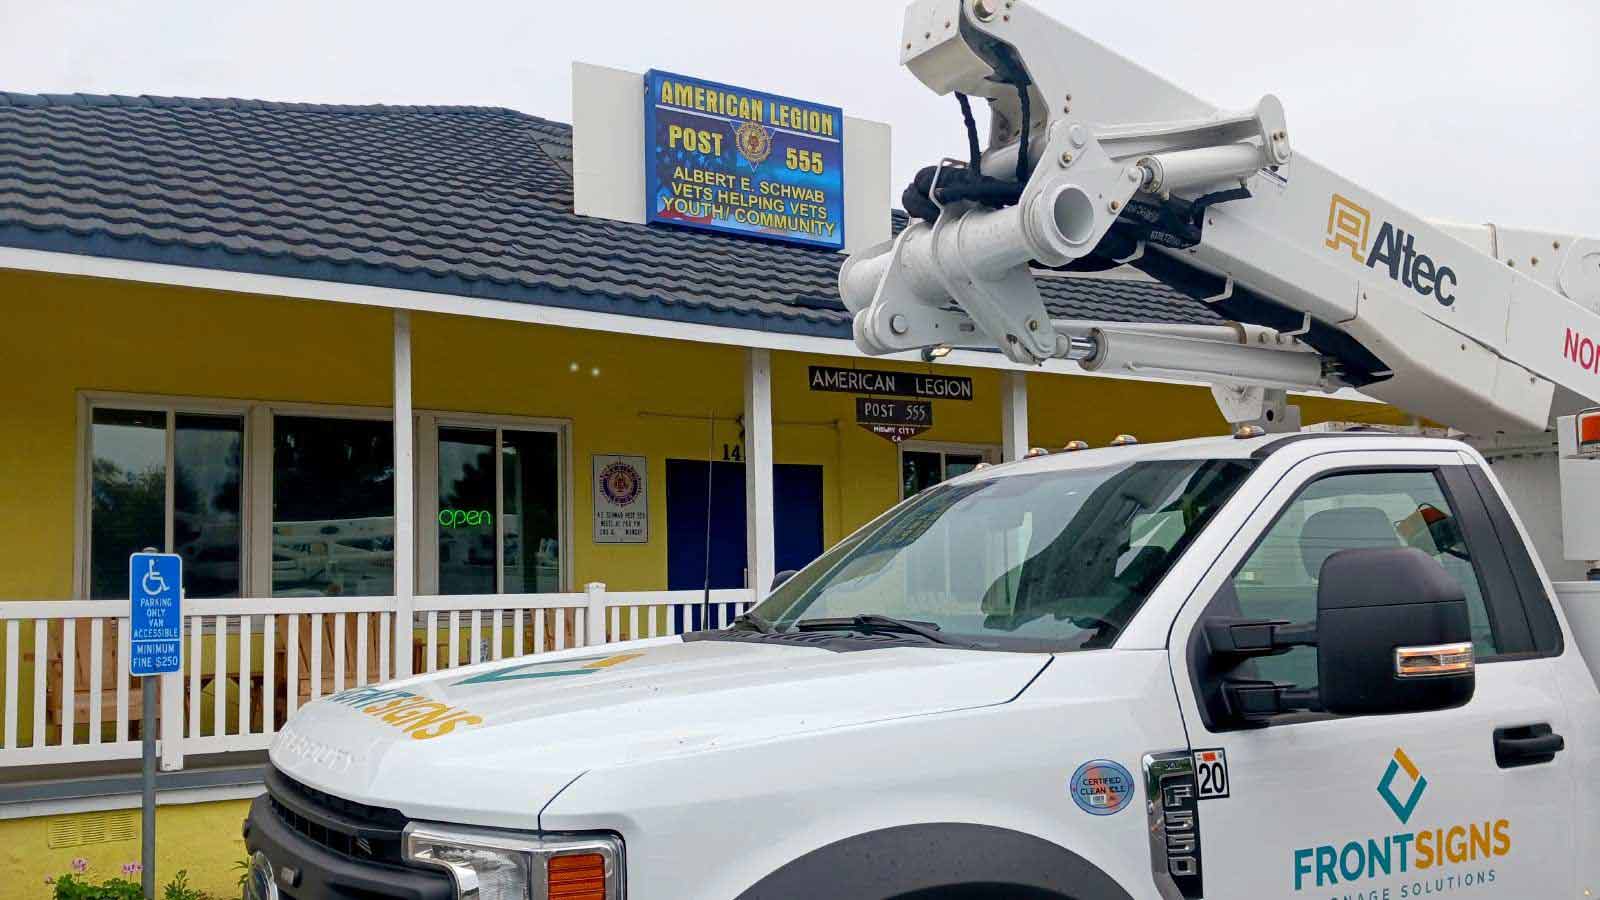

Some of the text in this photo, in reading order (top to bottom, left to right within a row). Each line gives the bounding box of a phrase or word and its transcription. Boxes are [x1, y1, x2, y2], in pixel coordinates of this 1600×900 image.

[661, 80, 833, 136] AMERICAN LEGION
[669, 124, 723, 157] POST
[786, 147, 824, 174] 555
[673, 166, 825, 203] ALBERT E. SCHWAB
[672, 182, 828, 219] VETS HELPING VETS
[663, 197, 835, 237] YOUTH/ COMMUNITY
[1366, 221, 1457, 307] Altec
[812, 369, 971, 397] AMERICAN LEGION
[865, 402, 926, 421] POST 555
[898, 427, 916, 435] CITY
[439, 509, 491, 528] open
[140, 598, 172, 608] PARKING
[146, 607, 166, 617] ONLY
[149, 618, 164, 627] VAN
[133, 628, 178, 639] ACCESSIBLE
[136, 643, 175, 654] MINIMUM
[133, 655, 178, 668] FINE $250
[1082, 776, 1121, 786] CERTIFIED
[1199, 762, 1225, 794] 20
[1080, 786, 1106, 795] CLEAN
[1294, 818, 1511, 891] FRONTSIGNS
[1400, 869, 1496, 898] SOLUTIONS
